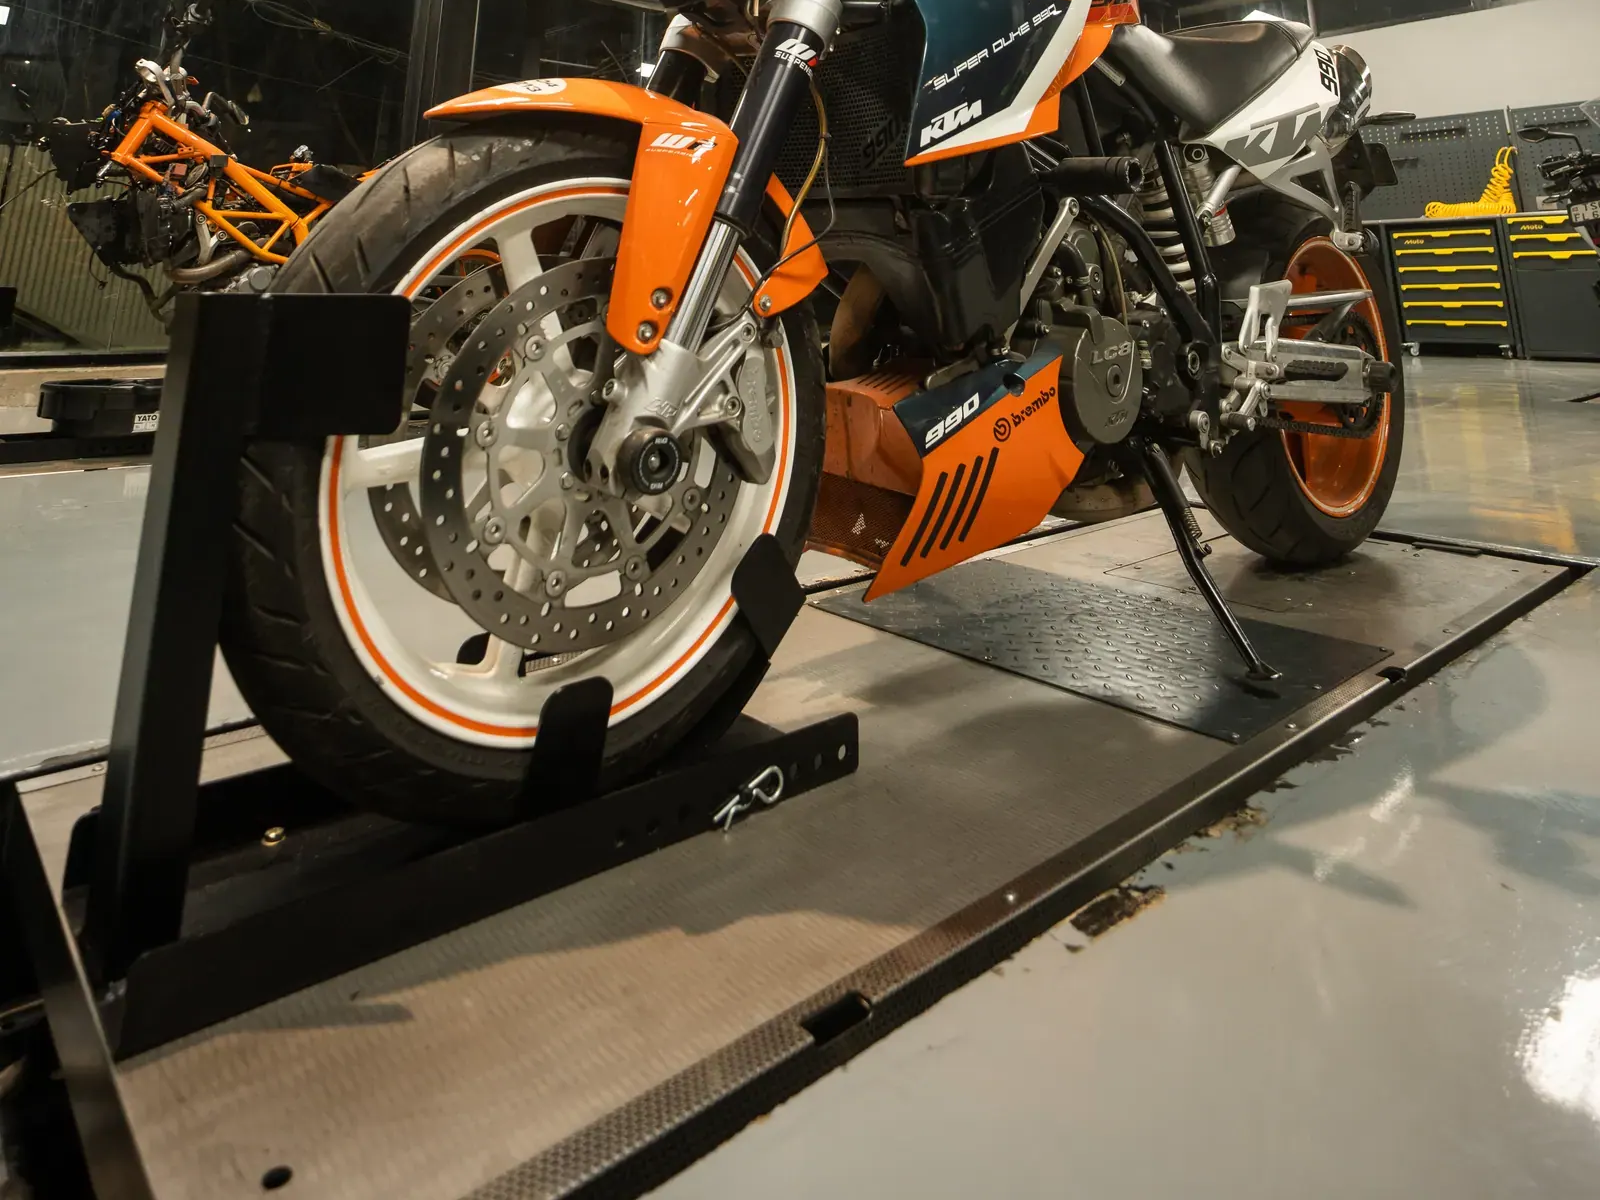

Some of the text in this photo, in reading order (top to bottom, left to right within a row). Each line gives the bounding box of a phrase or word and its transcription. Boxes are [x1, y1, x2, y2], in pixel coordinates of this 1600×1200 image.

[932, 3, 1060, 91] SUPER DUKE 990
[1312, 47, 1339, 98] 990
[920, 99, 983, 148] KTM
[1089, 340, 1133, 366] LC8
[137, 414, 158, 422] YATO
[925, 391, 980, 450] 990
[1010, 386, 1057, 428] brembo
